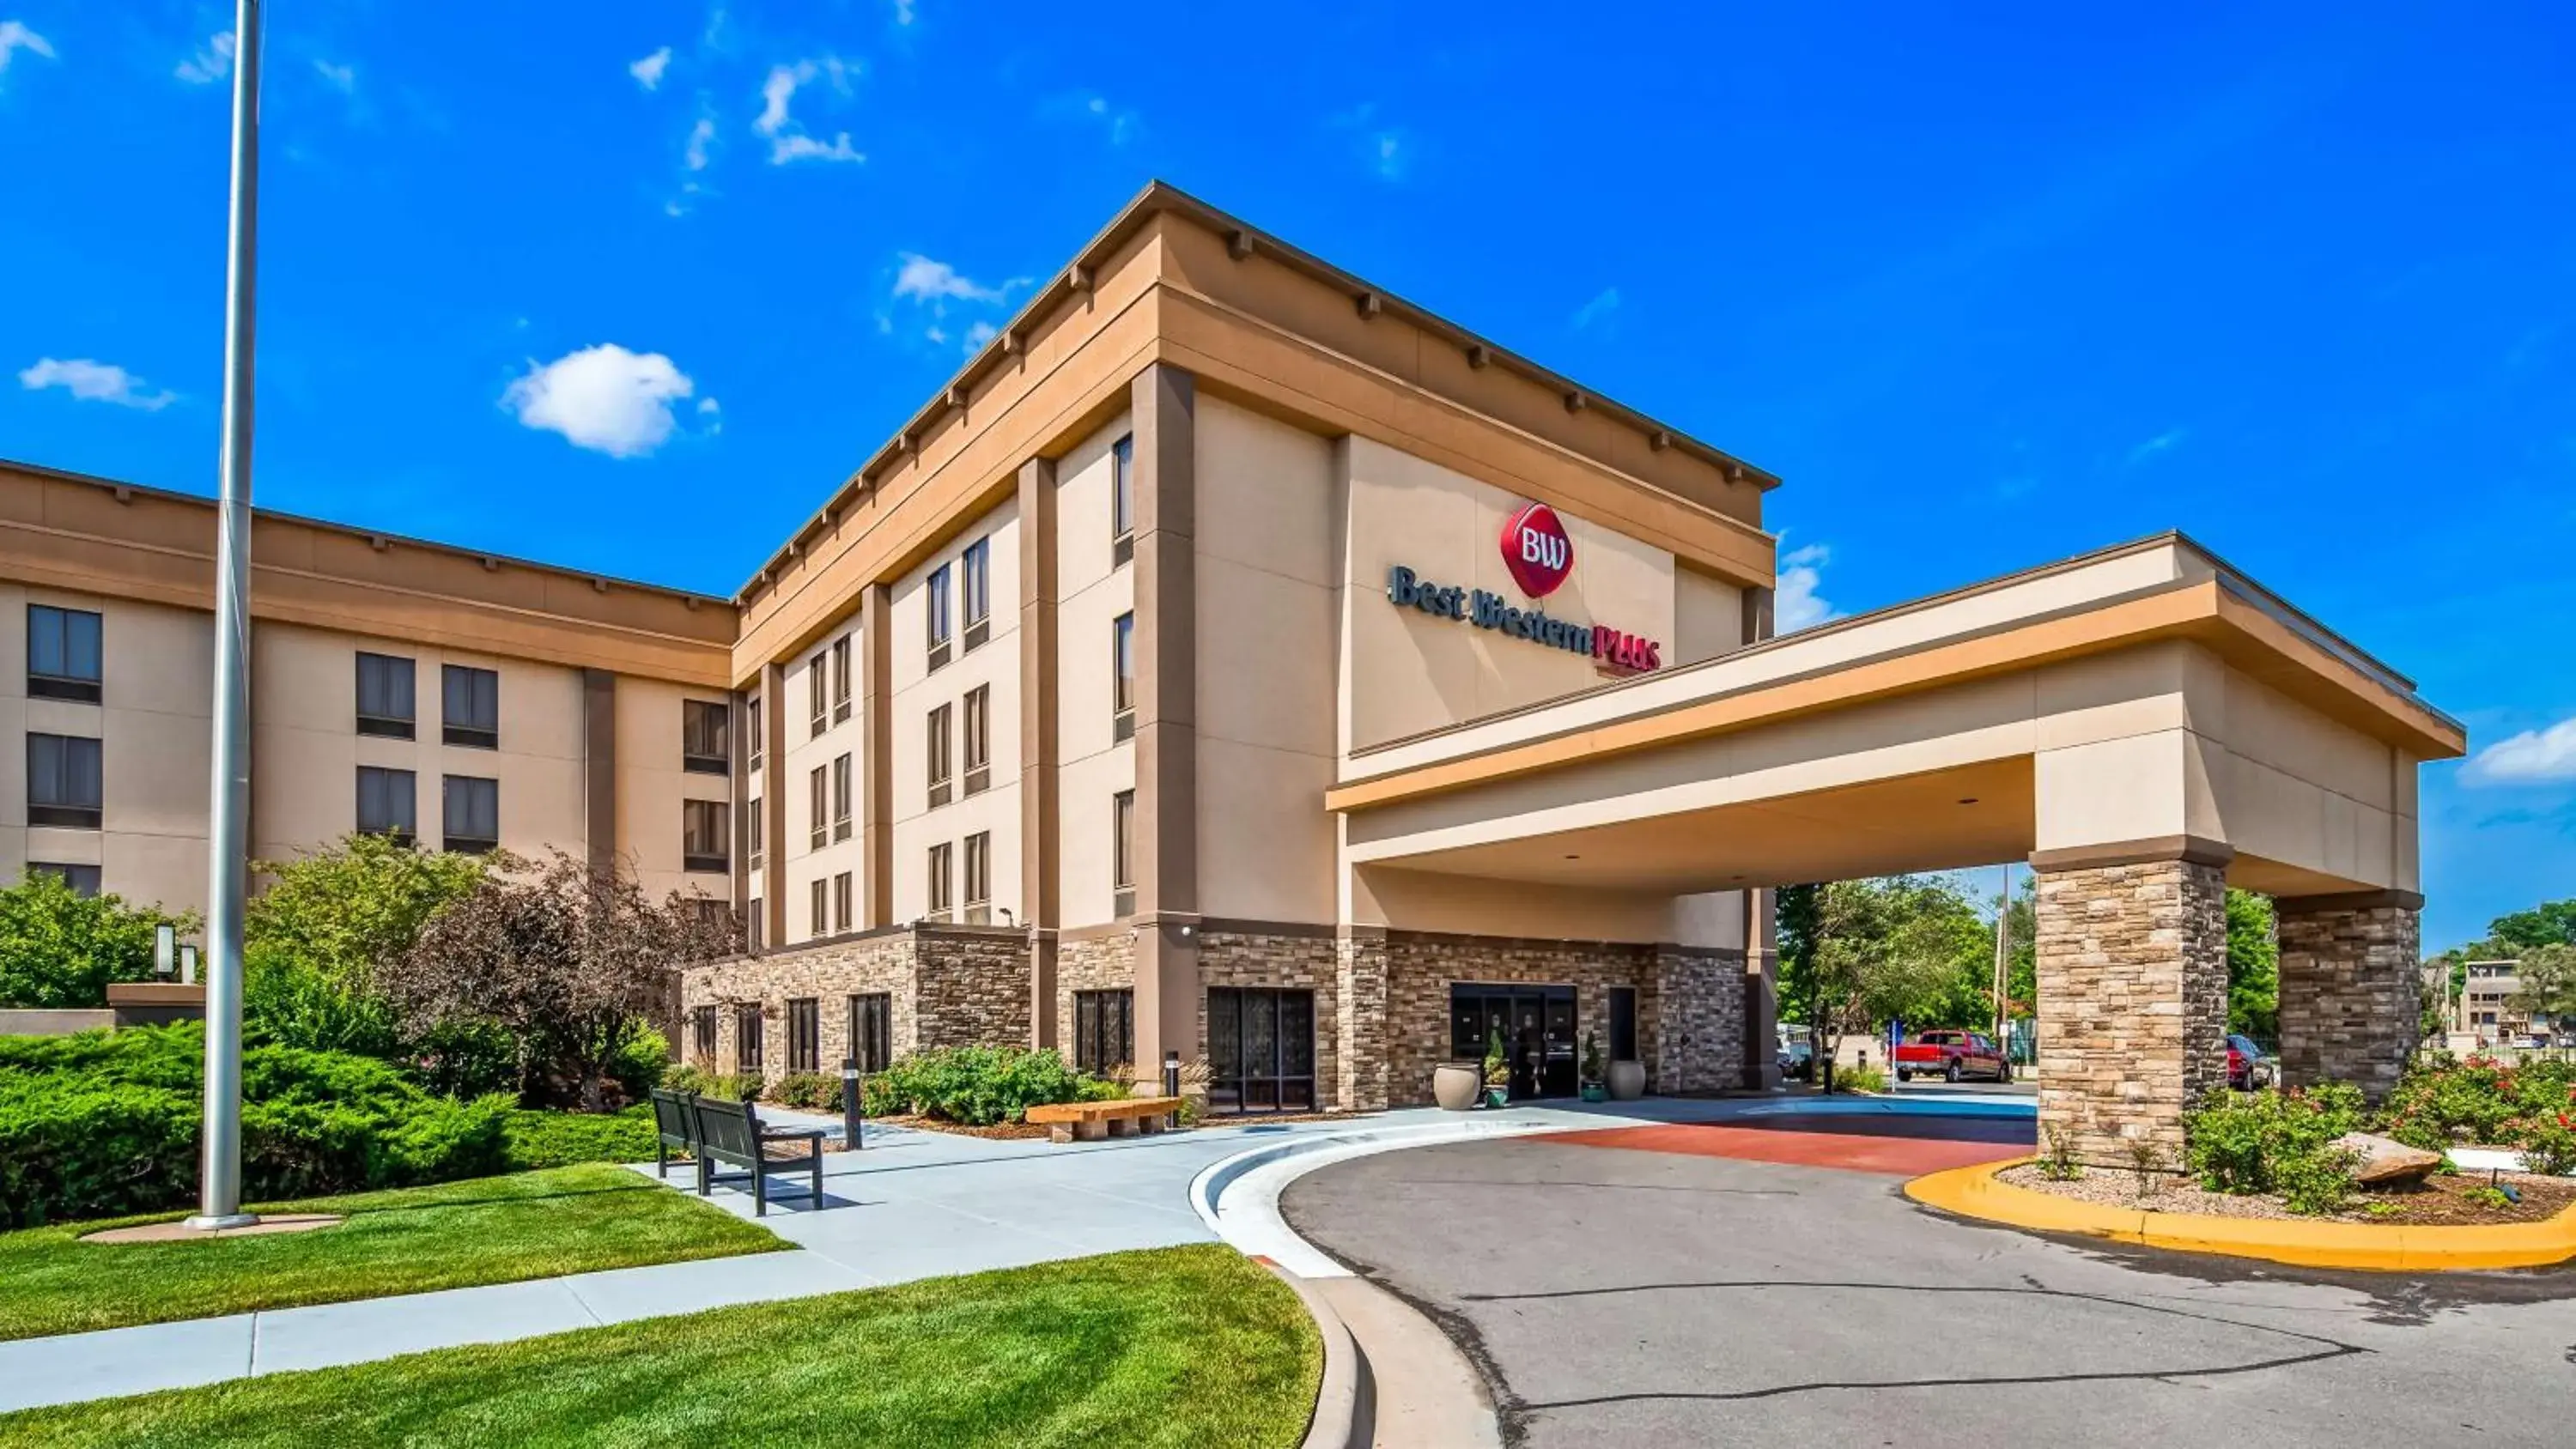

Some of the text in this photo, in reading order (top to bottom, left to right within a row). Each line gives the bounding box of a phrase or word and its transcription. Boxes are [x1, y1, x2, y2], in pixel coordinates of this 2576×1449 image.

[1522, 526, 1565, 571] BW
[1390, 566, 1661, 671] Best Western PLUS
